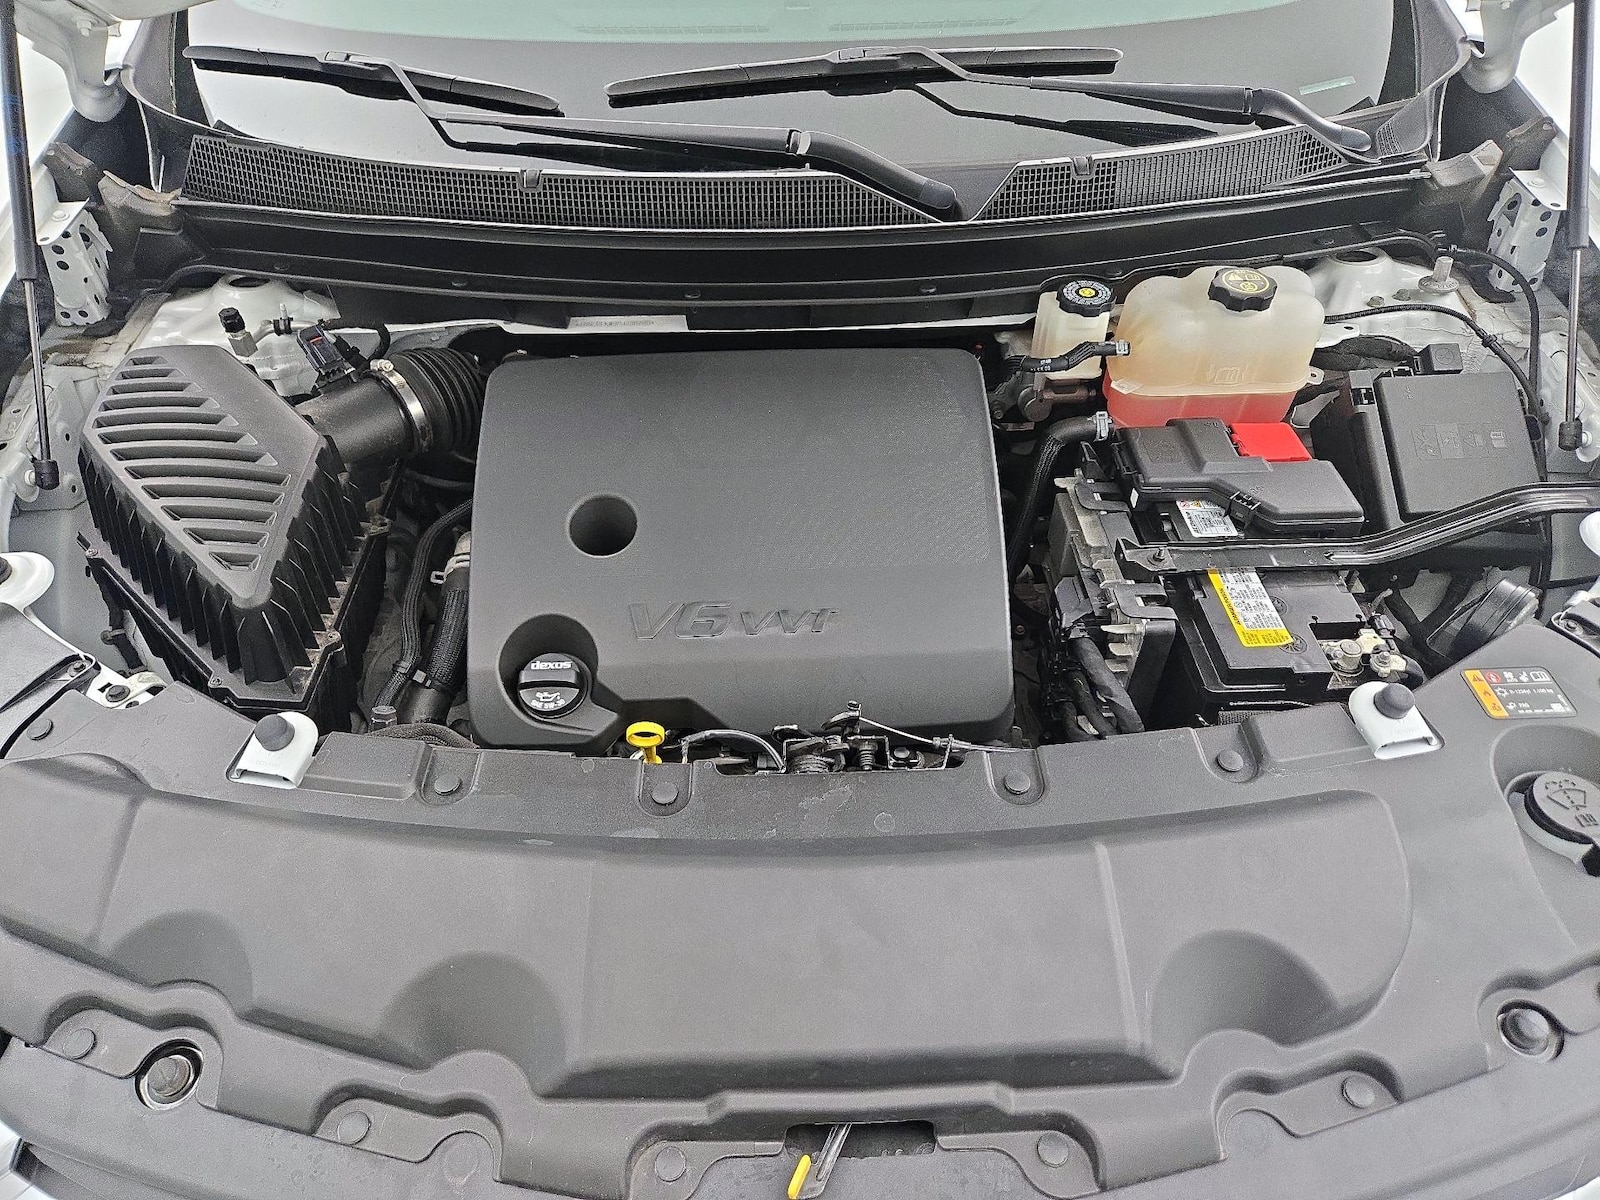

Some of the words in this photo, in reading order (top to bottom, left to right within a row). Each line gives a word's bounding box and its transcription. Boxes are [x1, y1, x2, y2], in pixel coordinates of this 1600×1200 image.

[628, 602, 732, 639] V6
[740, 608, 839, 636] VVT
[531, 661, 573, 670] dexos
